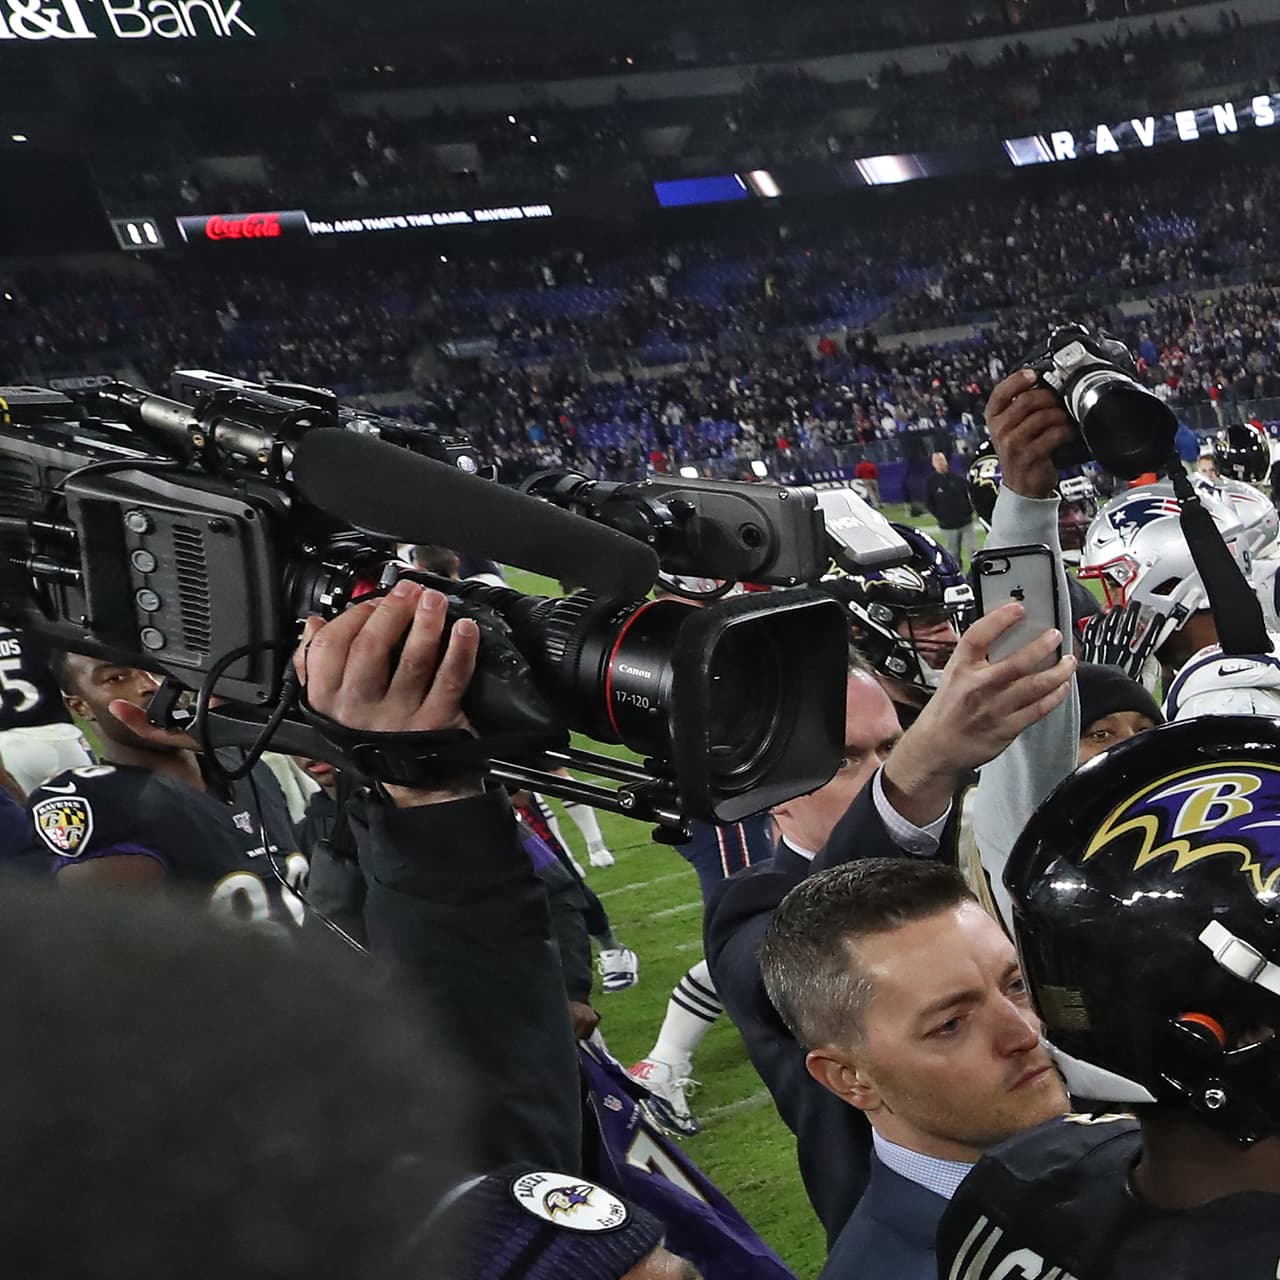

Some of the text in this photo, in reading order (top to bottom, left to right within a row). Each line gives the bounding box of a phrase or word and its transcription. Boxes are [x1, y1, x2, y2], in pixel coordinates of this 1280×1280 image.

[0, 0, 257, 40] &T Bank
[1051, 95, 1275, 161] RAVENS
[335, 219, 364, 232] AND
[406, 213, 434, 227] THE
[474, 207, 524, 222] RAVENS
[618, 663, 652, 680] Canon
[615, 690, 650, 709] 17-120
